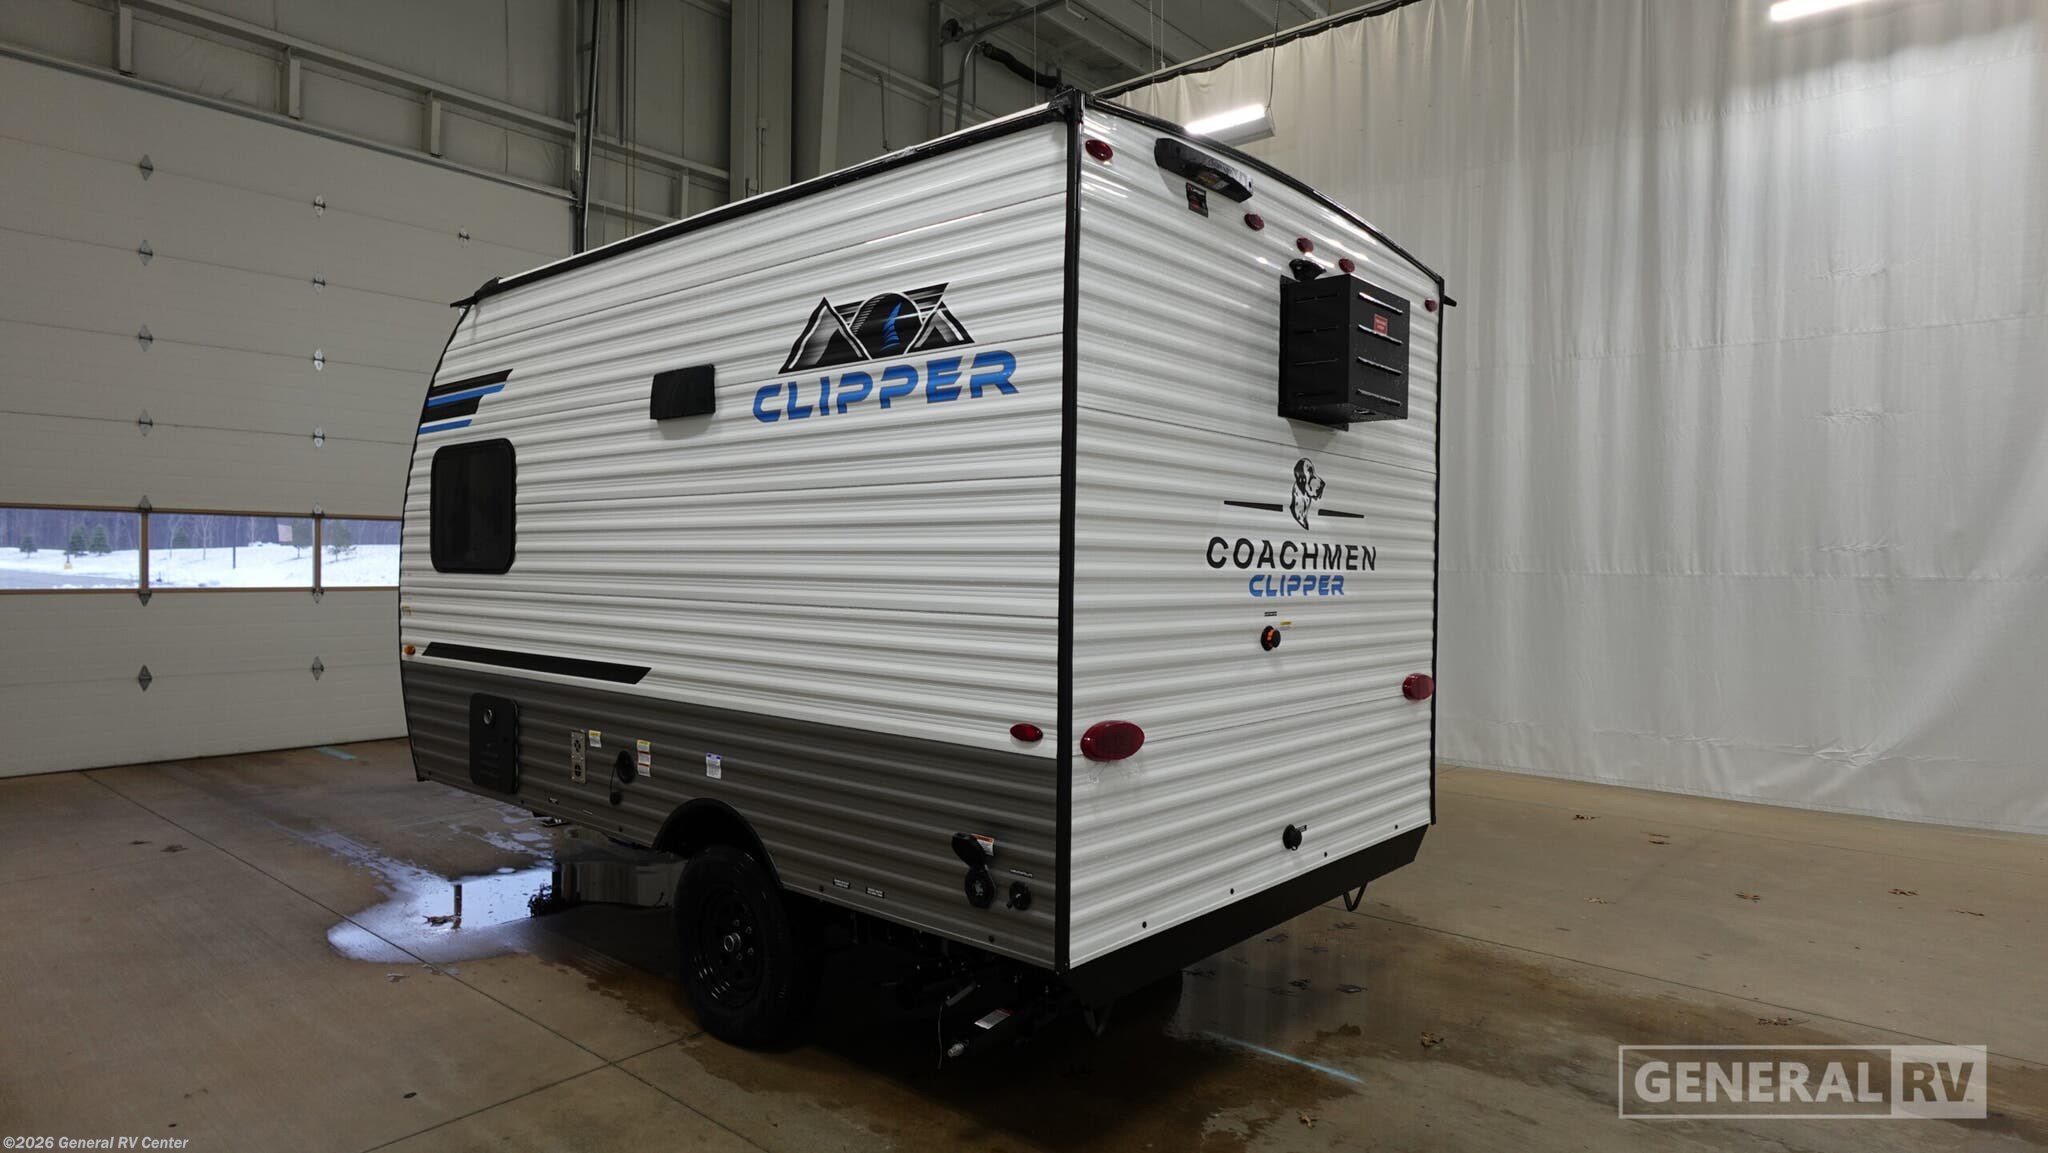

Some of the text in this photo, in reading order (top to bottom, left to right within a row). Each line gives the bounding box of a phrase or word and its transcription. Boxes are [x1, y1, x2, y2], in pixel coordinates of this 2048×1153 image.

[753, 350, 1019, 423] CLIPPER
[1206, 536, 1377, 571] COACHMEN
[1249, 574, 1345, 597] CLIPPER
